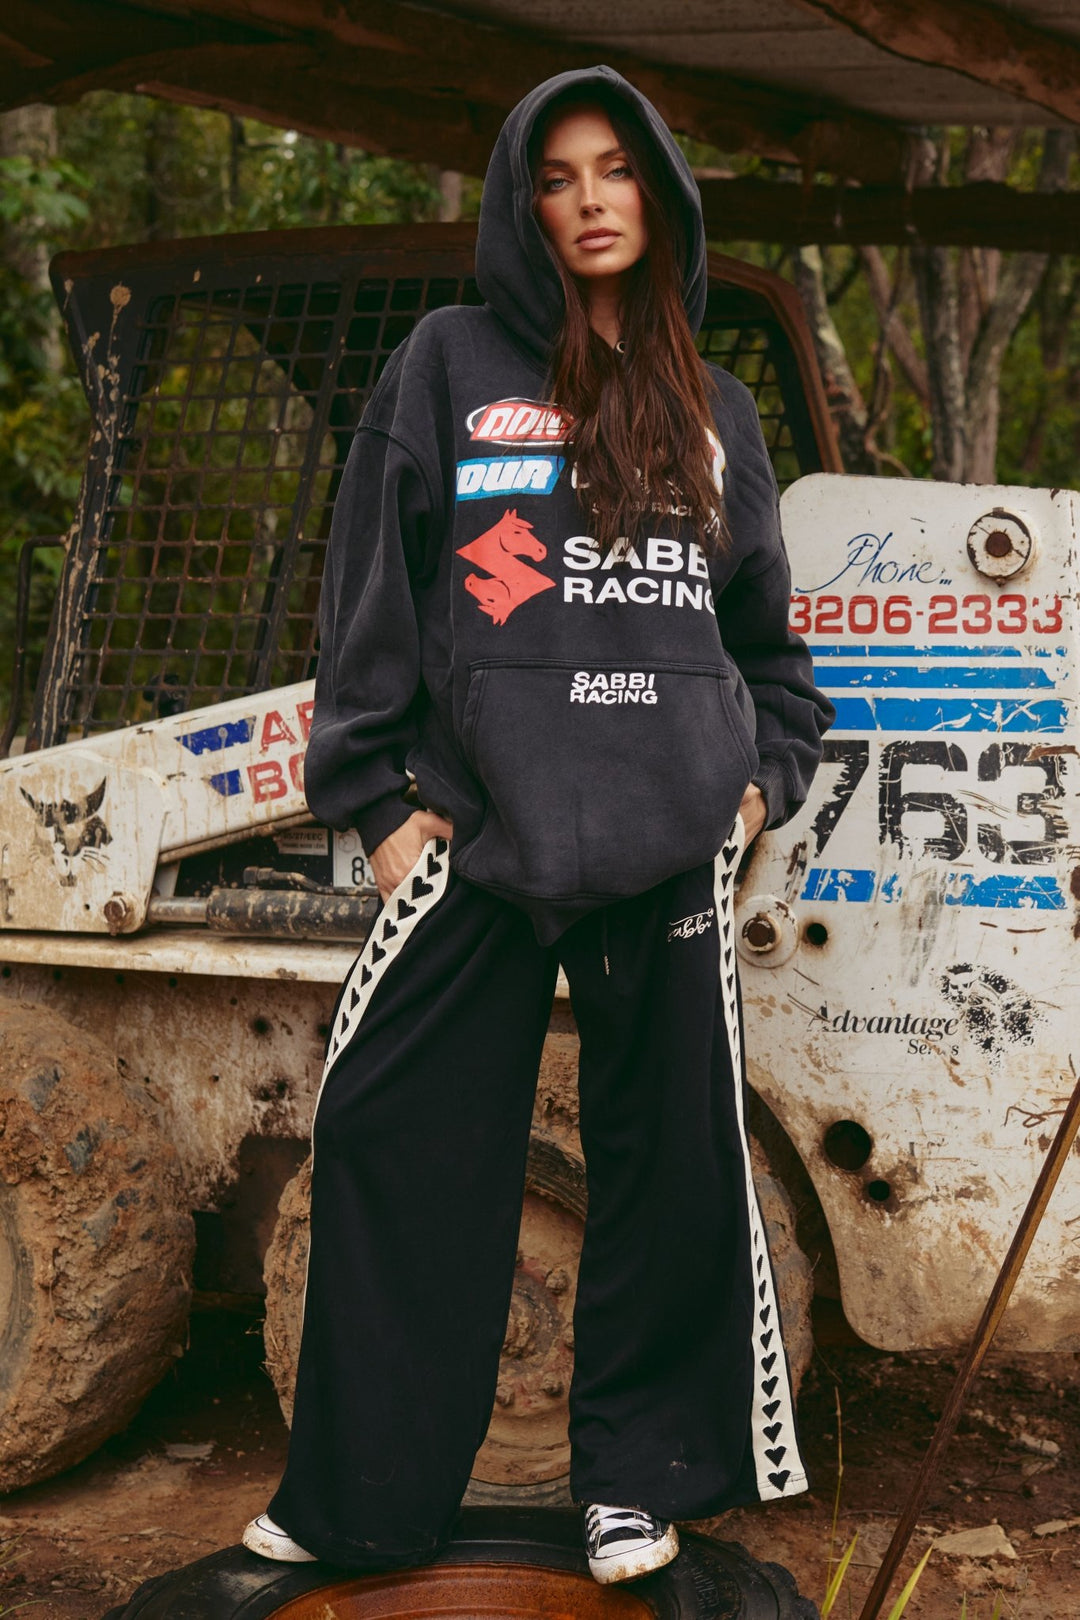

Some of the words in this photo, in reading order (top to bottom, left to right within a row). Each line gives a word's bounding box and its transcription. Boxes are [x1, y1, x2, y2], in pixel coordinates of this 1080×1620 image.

[457, 460, 553, 495] OUR
[788, 594, 1063, 634] 3206-2333
[570, 689, 658, 704] RACING
[571, 671, 655, 691] SABBI
[813, 740, 1072, 865] 763
[806, 1001, 959, 1042] Advantage
